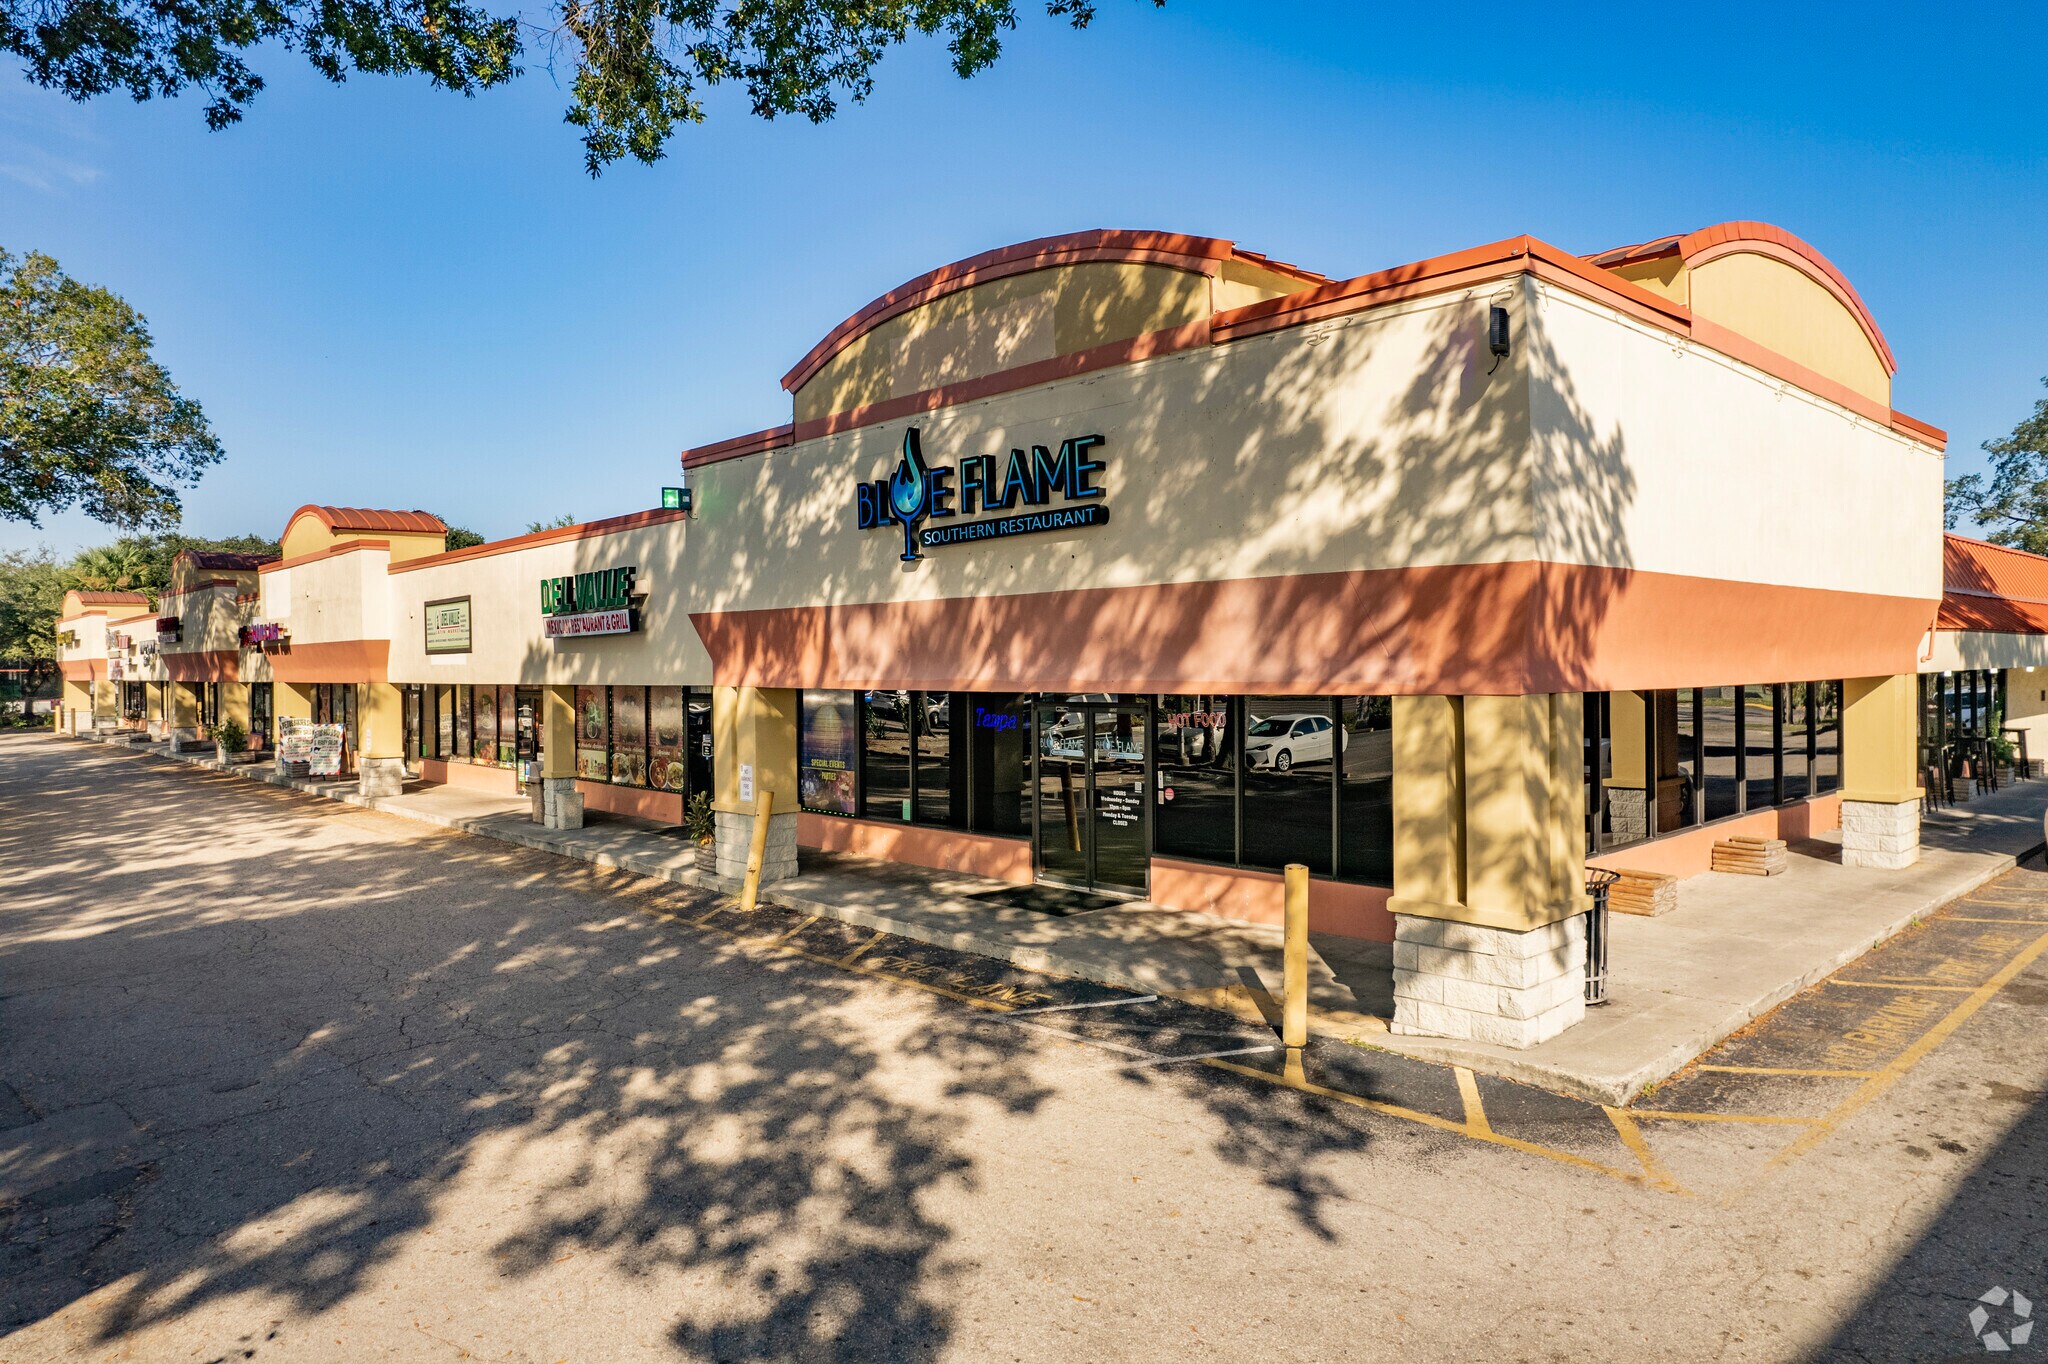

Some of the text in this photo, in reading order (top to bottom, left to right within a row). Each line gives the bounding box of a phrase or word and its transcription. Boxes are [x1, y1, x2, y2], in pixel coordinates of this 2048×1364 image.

[857, 434, 1106, 545] BLUE FLAME
[924, 507, 1096, 545] SOUTHERN RESTAURANT
[540, 567, 631, 614] DEL VALLE
[611, 613, 629, 631] GRILL
[975, 707, 1017, 732] Tampa
[1167, 711, 1227, 728] HOT FOOD
[811, 759, 828, 767] SPECIAL
[1101, 796, 1123, 804] Wednesday
[1122, 813, 1138, 821] Tuesday
